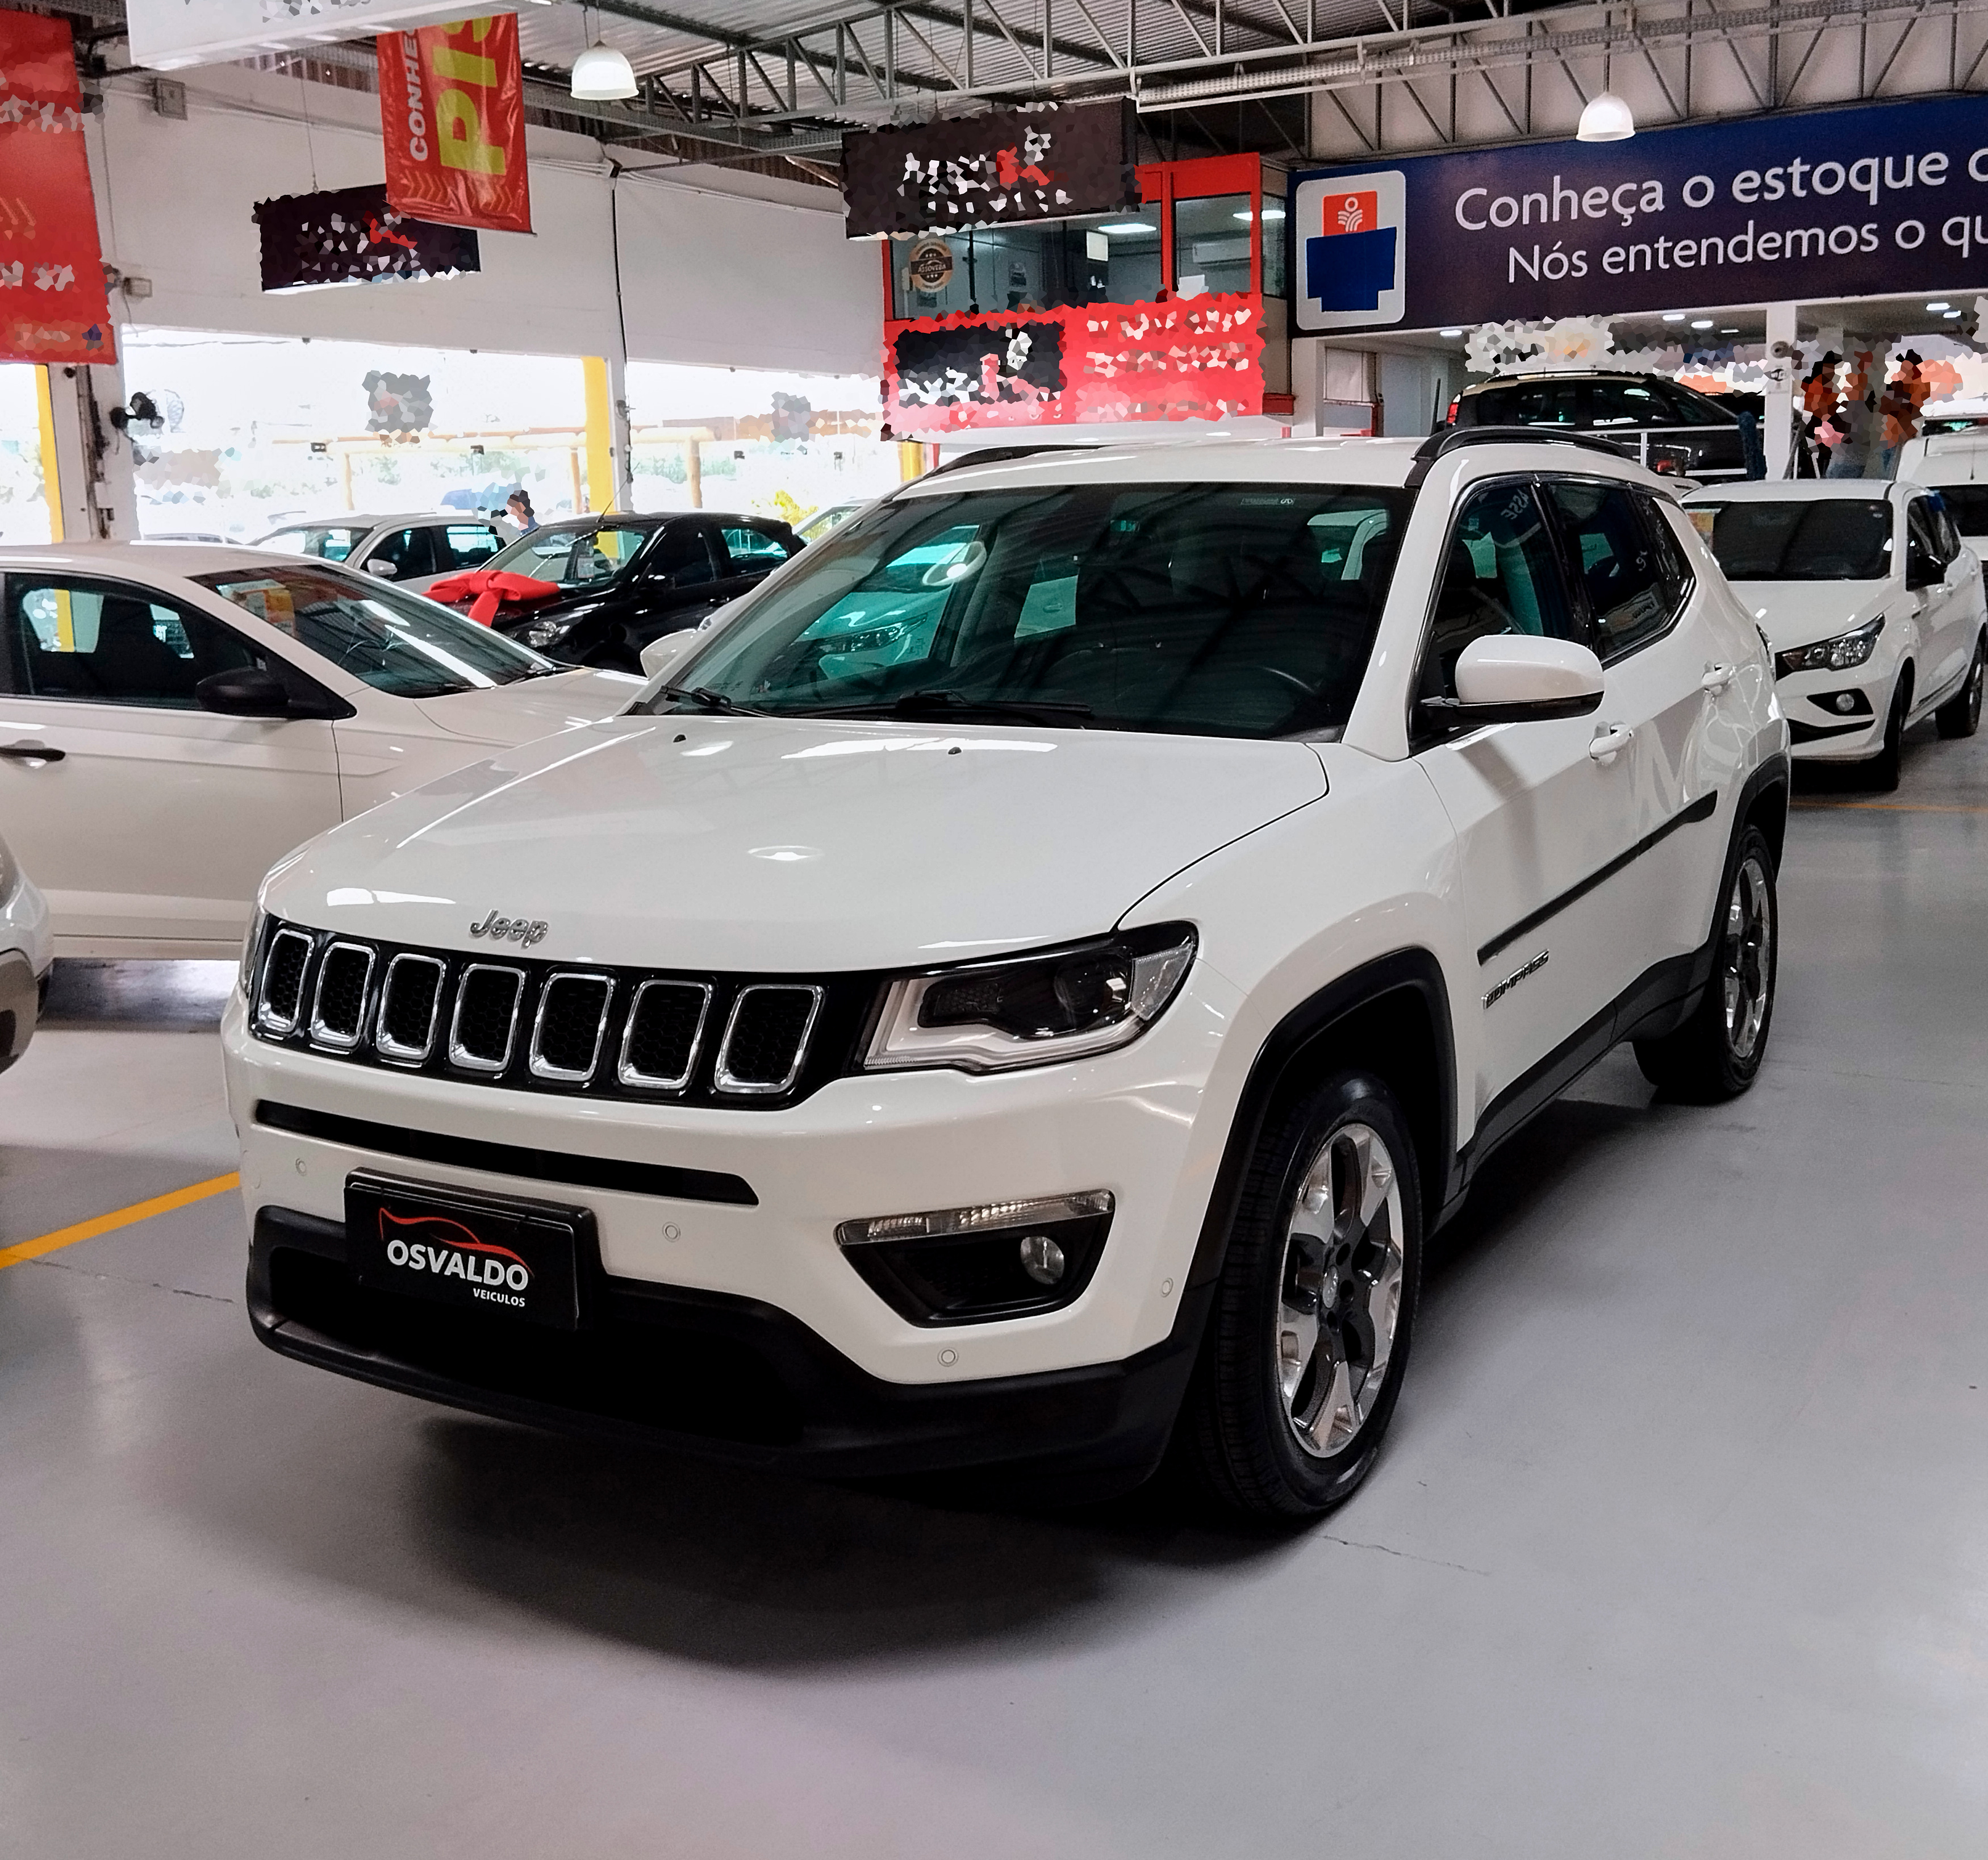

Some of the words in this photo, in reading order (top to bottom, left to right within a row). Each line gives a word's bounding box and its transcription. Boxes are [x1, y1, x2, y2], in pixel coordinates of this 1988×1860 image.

[404, 30, 428, 161] CONHE
[1455, 175, 1666, 231] Conheça
[1682, 175, 1715, 208] o
[1732, 152, 1949, 206] estoque
[1509, 240, 1588, 283] Nós
[1602, 220, 1879, 274] entendemos
[1895, 220, 1926, 249] o
[470, 909, 549, 949] Jeep
[1481, 949, 1550, 1010] COMPASS
[387, 1240, 528, 1291] OSVALDO
[473, 1288, 525, 1307] VEICULOS
